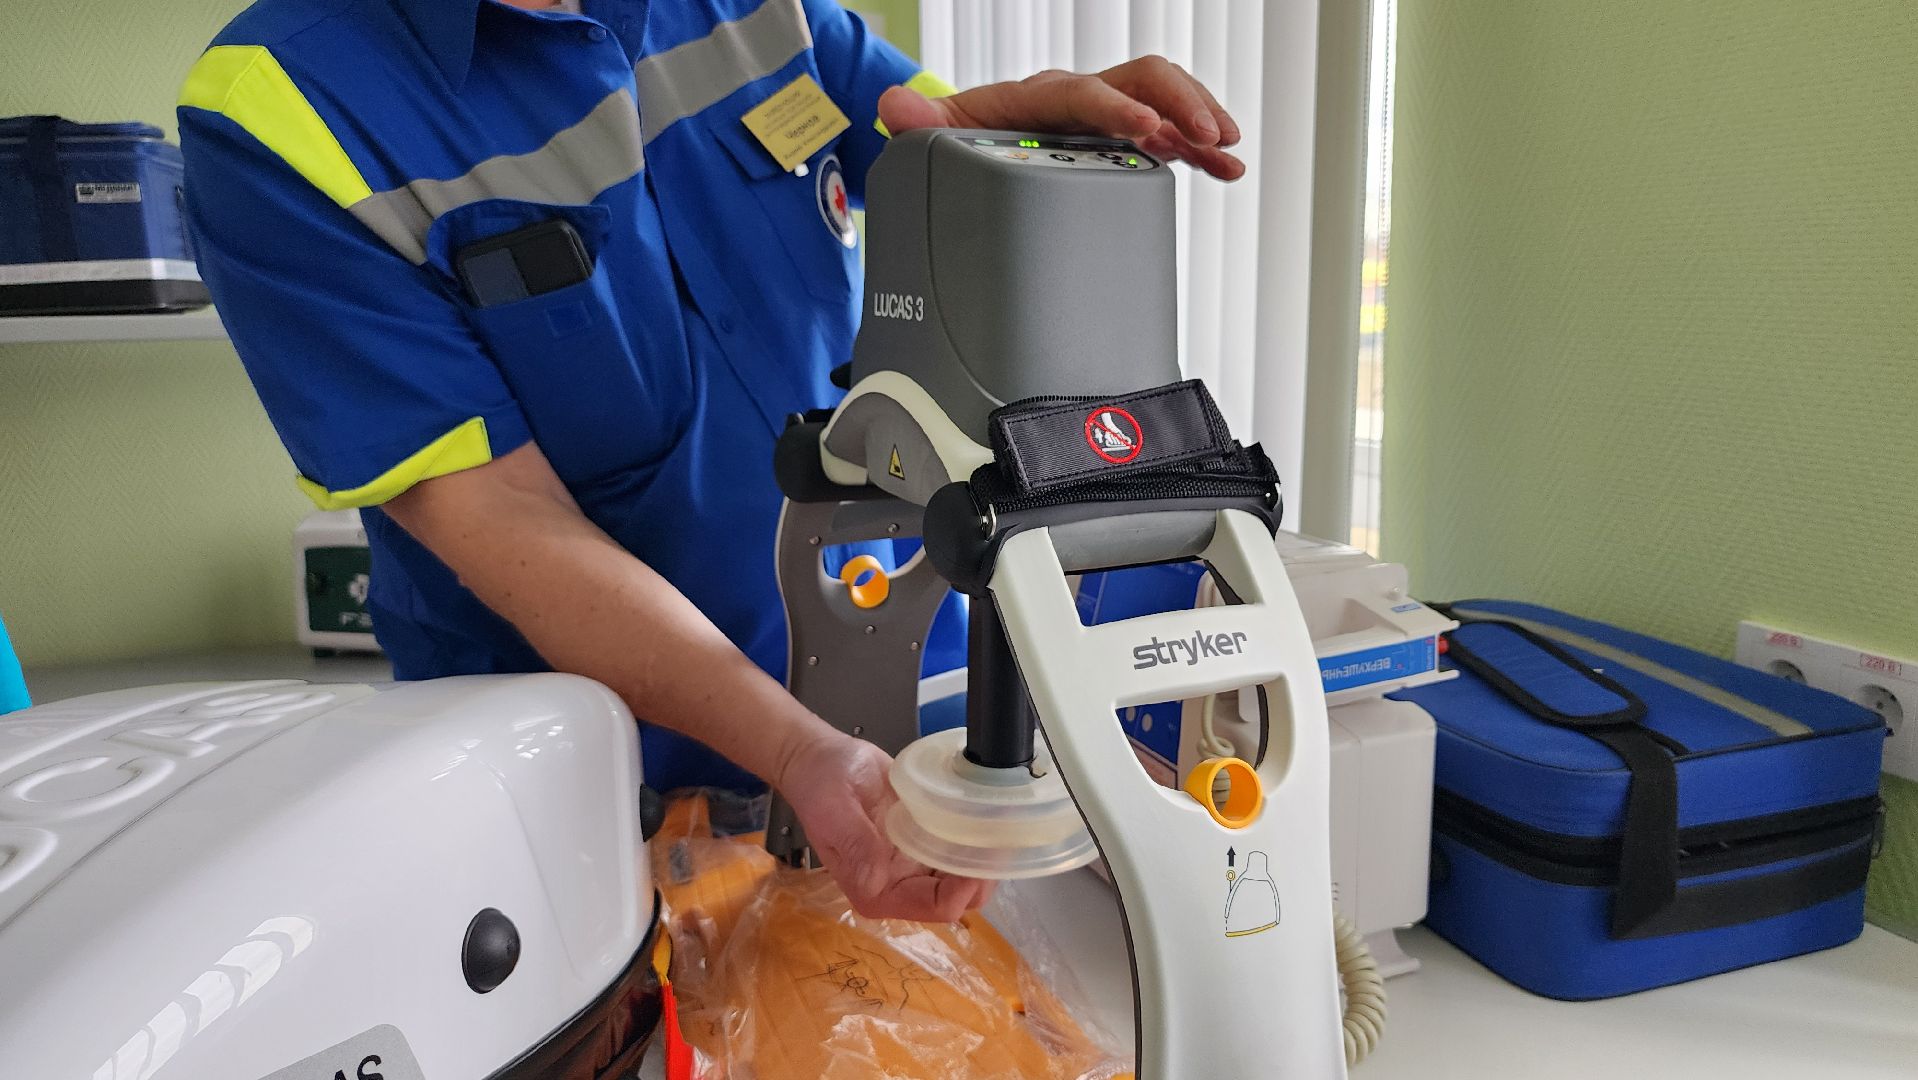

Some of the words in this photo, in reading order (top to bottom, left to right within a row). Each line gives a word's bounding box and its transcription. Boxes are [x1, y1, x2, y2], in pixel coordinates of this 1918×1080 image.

[874, 292, 913, 320] LUCAS
[915, 296, 924, 322] 3
[1133, 630, 1247, 670] stryker
[1865, 655, 1885, 671] 220
